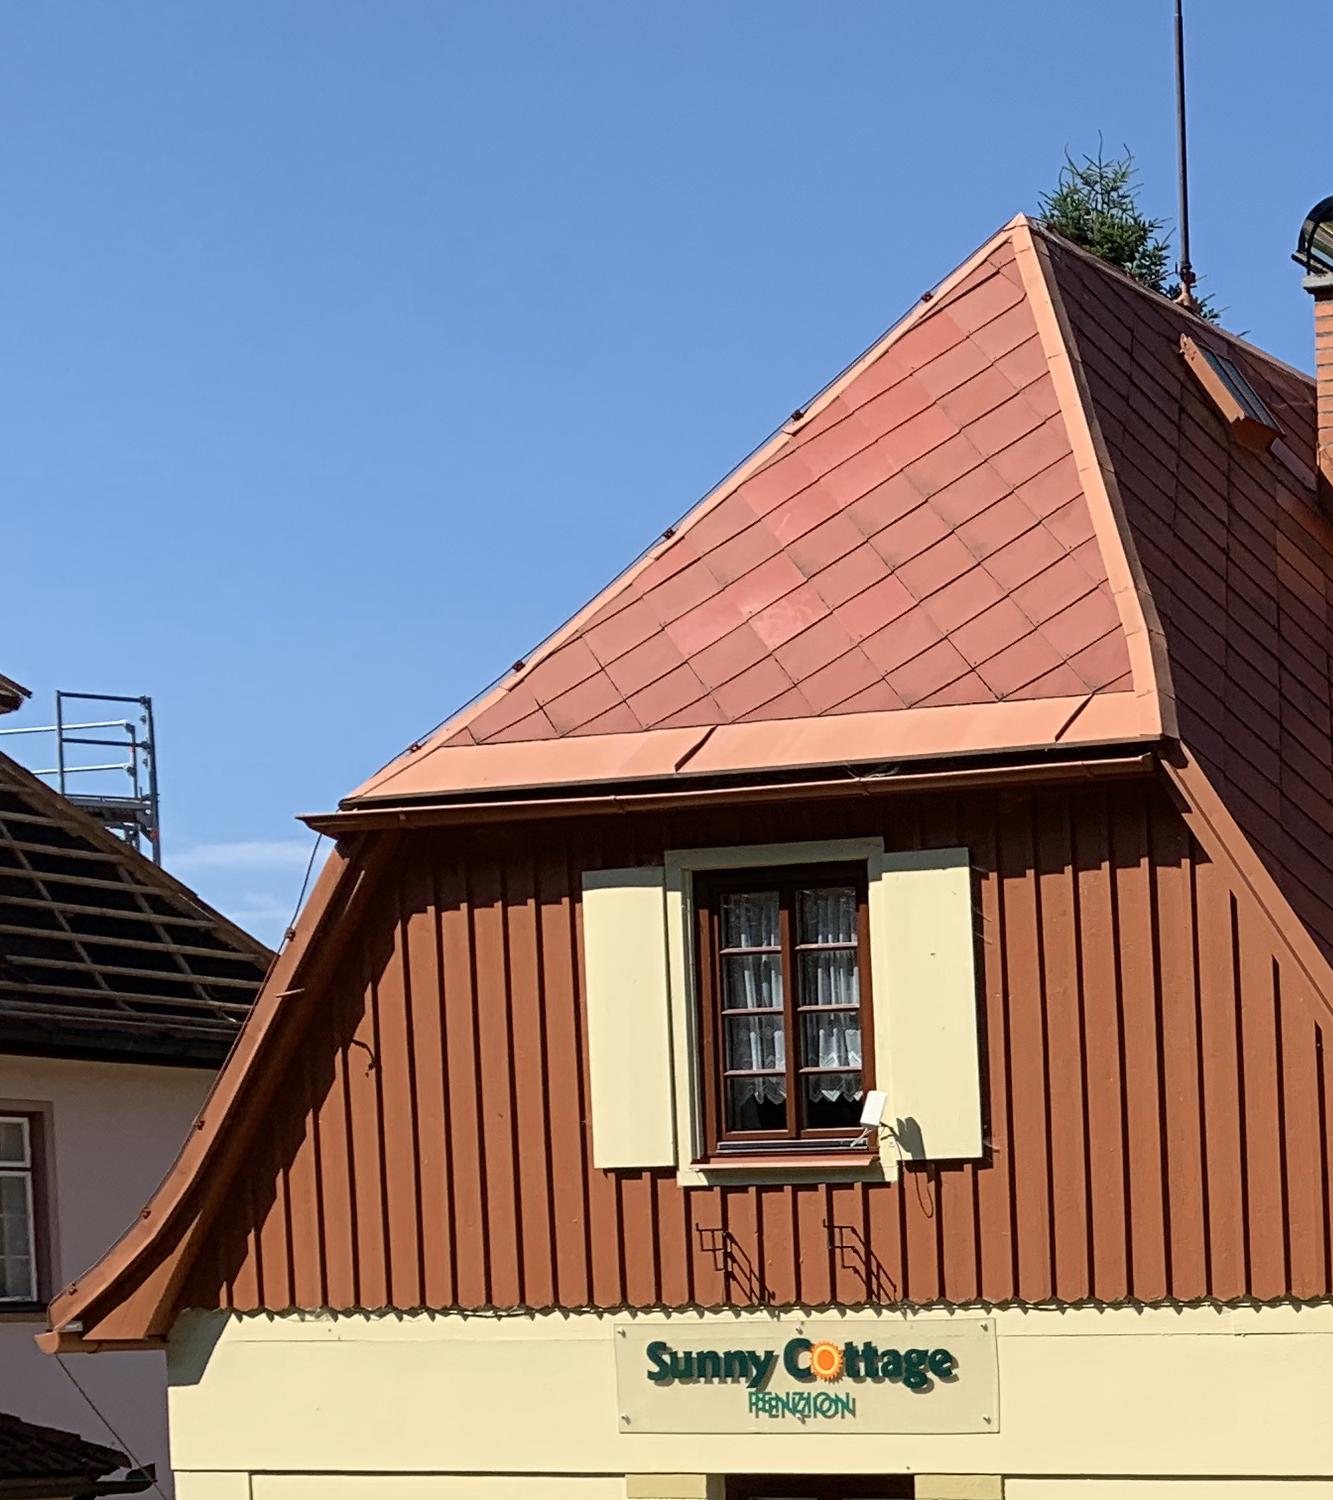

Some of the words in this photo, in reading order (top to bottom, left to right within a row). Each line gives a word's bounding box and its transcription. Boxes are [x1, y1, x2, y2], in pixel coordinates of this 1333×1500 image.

[646, 1340, 775, 1388] Sunny
[783, 1337, 955, 1389] Cottage
[748, 1391, 853, 1416] PENZION
